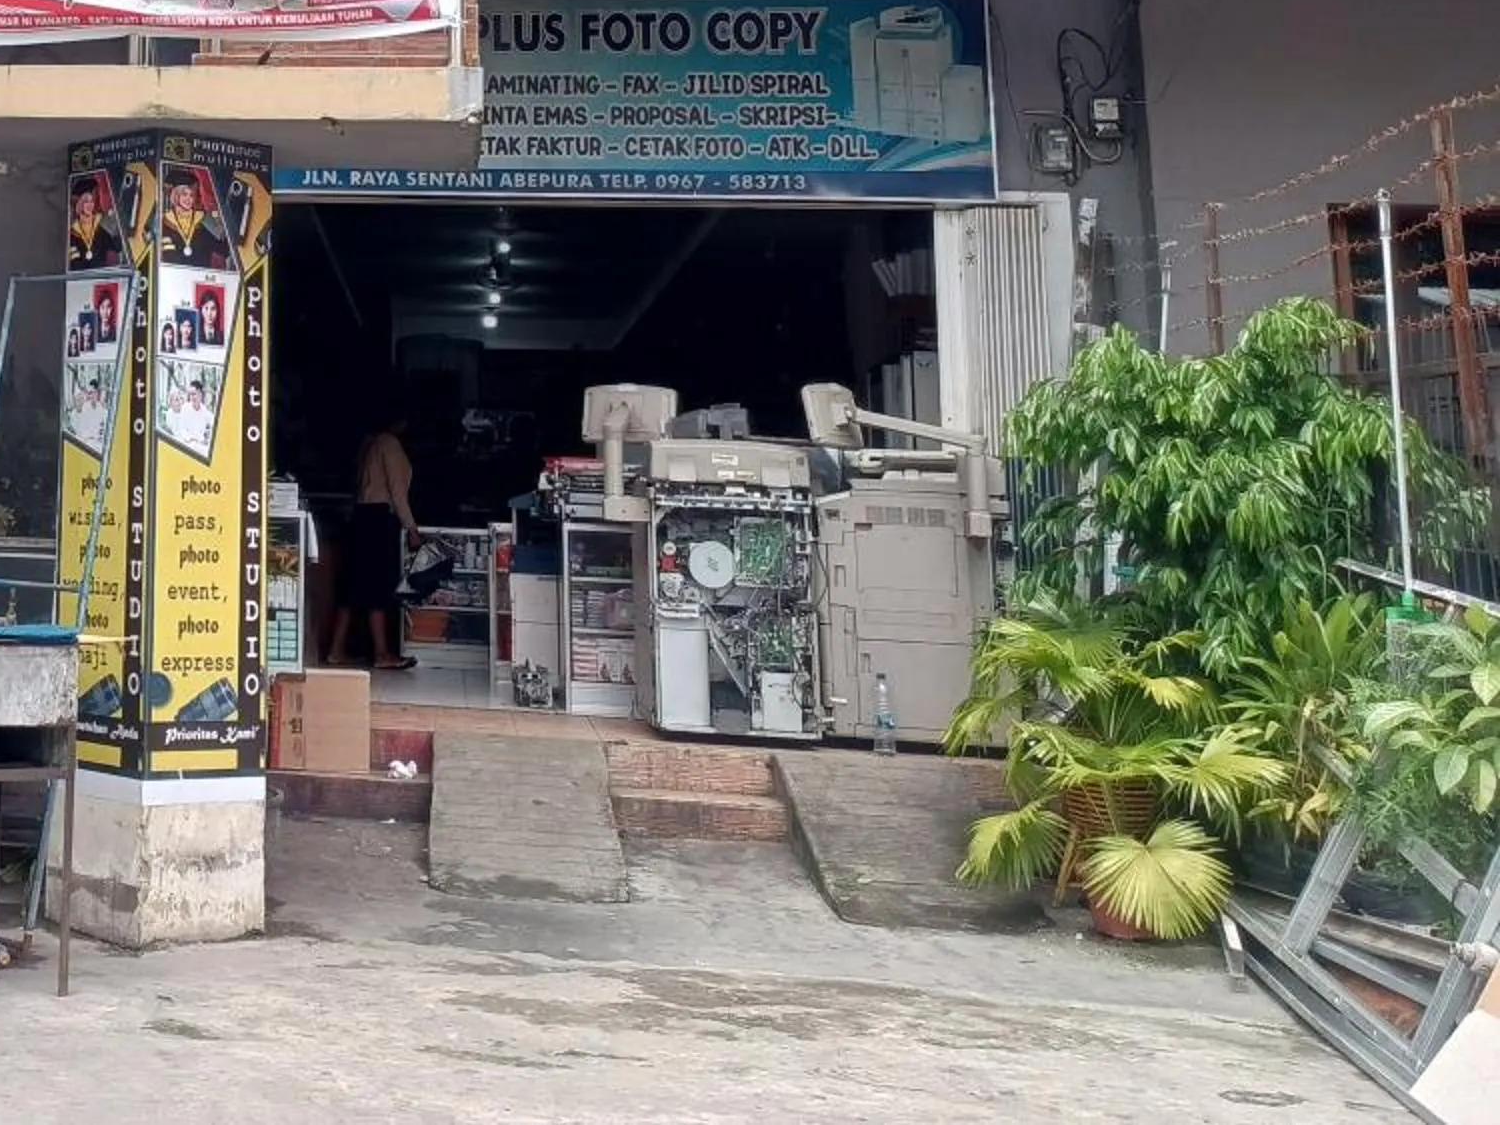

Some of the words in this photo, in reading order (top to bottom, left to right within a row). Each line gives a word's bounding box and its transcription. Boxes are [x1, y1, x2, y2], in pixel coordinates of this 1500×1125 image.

[237, 14, 273, 26] UNTUK
[338, 8, 373, 22] TUHAN
[580, 12, 691, 53] FOTO
[707, 10, 822, 53] COPY
[484, 74, 601, 96] AMINATING
[622, 74, 660, 95] FAX
[683, 74, 746, 95] JILID
[750, 74, 829, 95] SPIRAL
[483, 106, 527, 126] INTA
[533, 106, 588, 126] EMAS
[610, 106, 715, 126] PROPOSAL
[480, 136, 521, 156] TAK
[527, 136, 602, 156] FAKTUR
[625, 136, 695, 156] CETAK
[697, 136, 744, 156] FOTO
[767, 136, 808, 156] ATK
[830, 136, 878, 157] DLL.
[302, 170, 343, 186] JLN.
[350, 170, 400, 186] RAYA
[406, 172, 492, 187] SENTANI
[499, 173, 594, 190] ABEPURA
[601, 174, 649, 190] TELP.
[655, 175, 703, 190] 0967
[728, 175, 806, 191] 583713
[247, 286, 261, 442] photo
[81, 472, 112, 496] phoo
[181, 475, 221, 496] photo
[68, 507, 122, 531] wisda,
[174, 515, 223, 535] pass,
[79, 544, 110, 563] pto
[179, 544, 220, 568] photo
[129, 486, 143, 695] STUDIO
[167, 583, 228, 603] event,
[245, 492, 260, 695] STUDIO
[178, 614, 219, 639] photo
[161, 655, 235, 677] express
